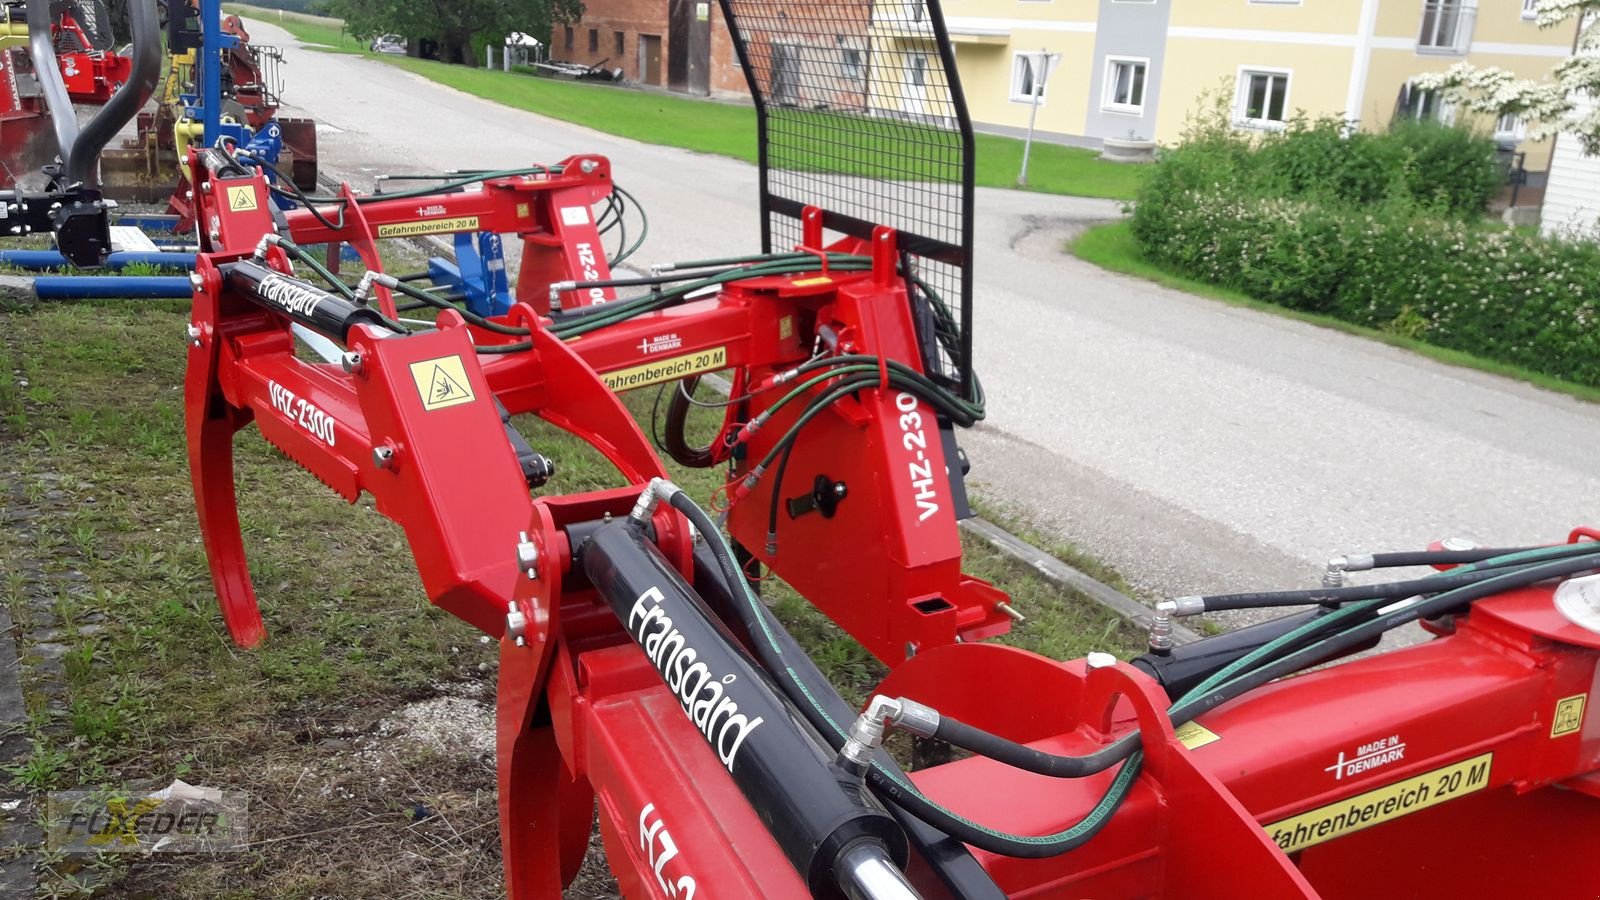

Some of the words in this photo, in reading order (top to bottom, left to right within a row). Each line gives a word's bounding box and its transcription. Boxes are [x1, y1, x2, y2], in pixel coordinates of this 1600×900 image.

[380, 220, 454, 236] Gefahrenbereich
[456, 220, 467, 229] 20
[469, 219, 477, 227] M
[576, 243, 606, 306] HZ-200
[605, 359, 691, 388] ahrenbereich
[695, 355, 710, 369] 20
[713, 351, 723, 364] M
[650, 341, 681, 352] DENMARK
[269, 380, 335, 447] VHZ-2300
[896, 392, 939, 522] VHZ-230
[628, 585, 764, 773] Fransgård
[1346, 748, 1405, 776] DENMARK
[1357, 739, 1386, 756] MADE
[1388, 735, 1398, 746] IN
[1272, 782, 1429, 849] fahrenbereich
[1435, 771, 1462, 797] 20
[1466, 762, 1487, 787] M
